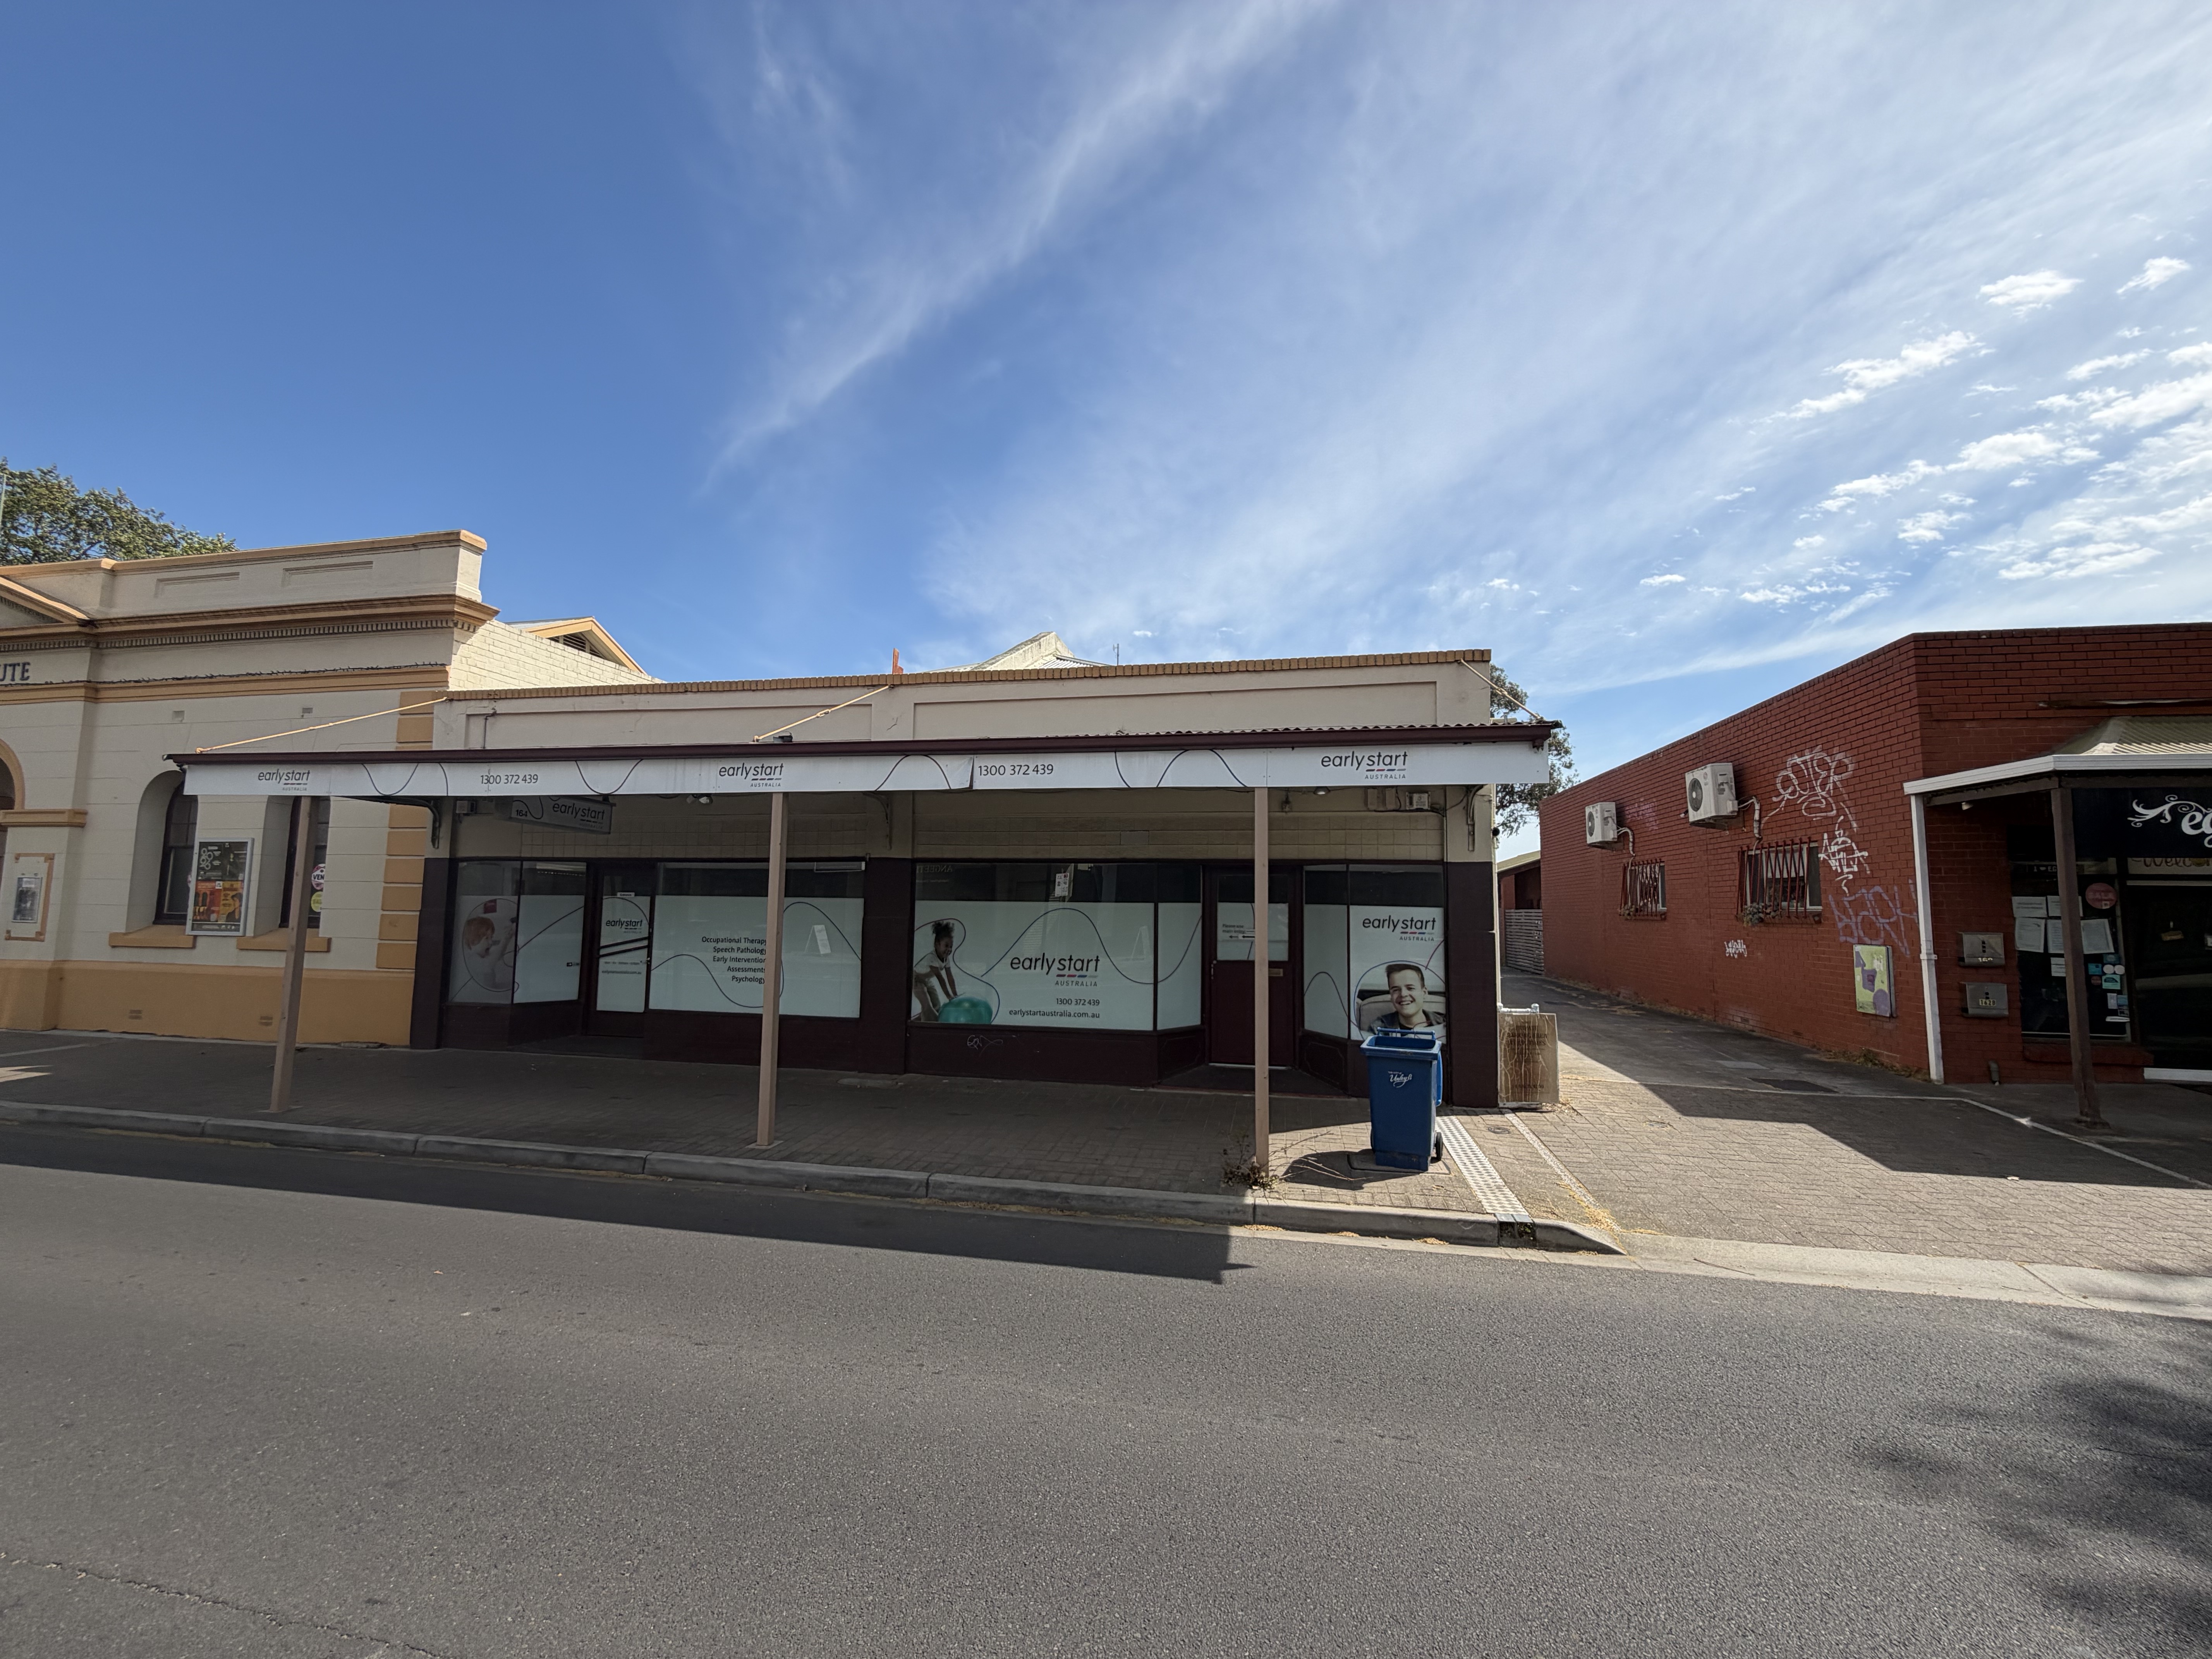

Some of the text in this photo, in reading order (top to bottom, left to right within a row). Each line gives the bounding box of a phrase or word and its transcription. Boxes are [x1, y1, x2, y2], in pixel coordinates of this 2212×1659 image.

[978, 764, 1054, 776] 1300 372 439
[481, 774, 538, 784] 1300 372 439
[713, 956, 728, 964] Early
[1009, 1008, 1100, 1018] earlystartaustralia.com.au
